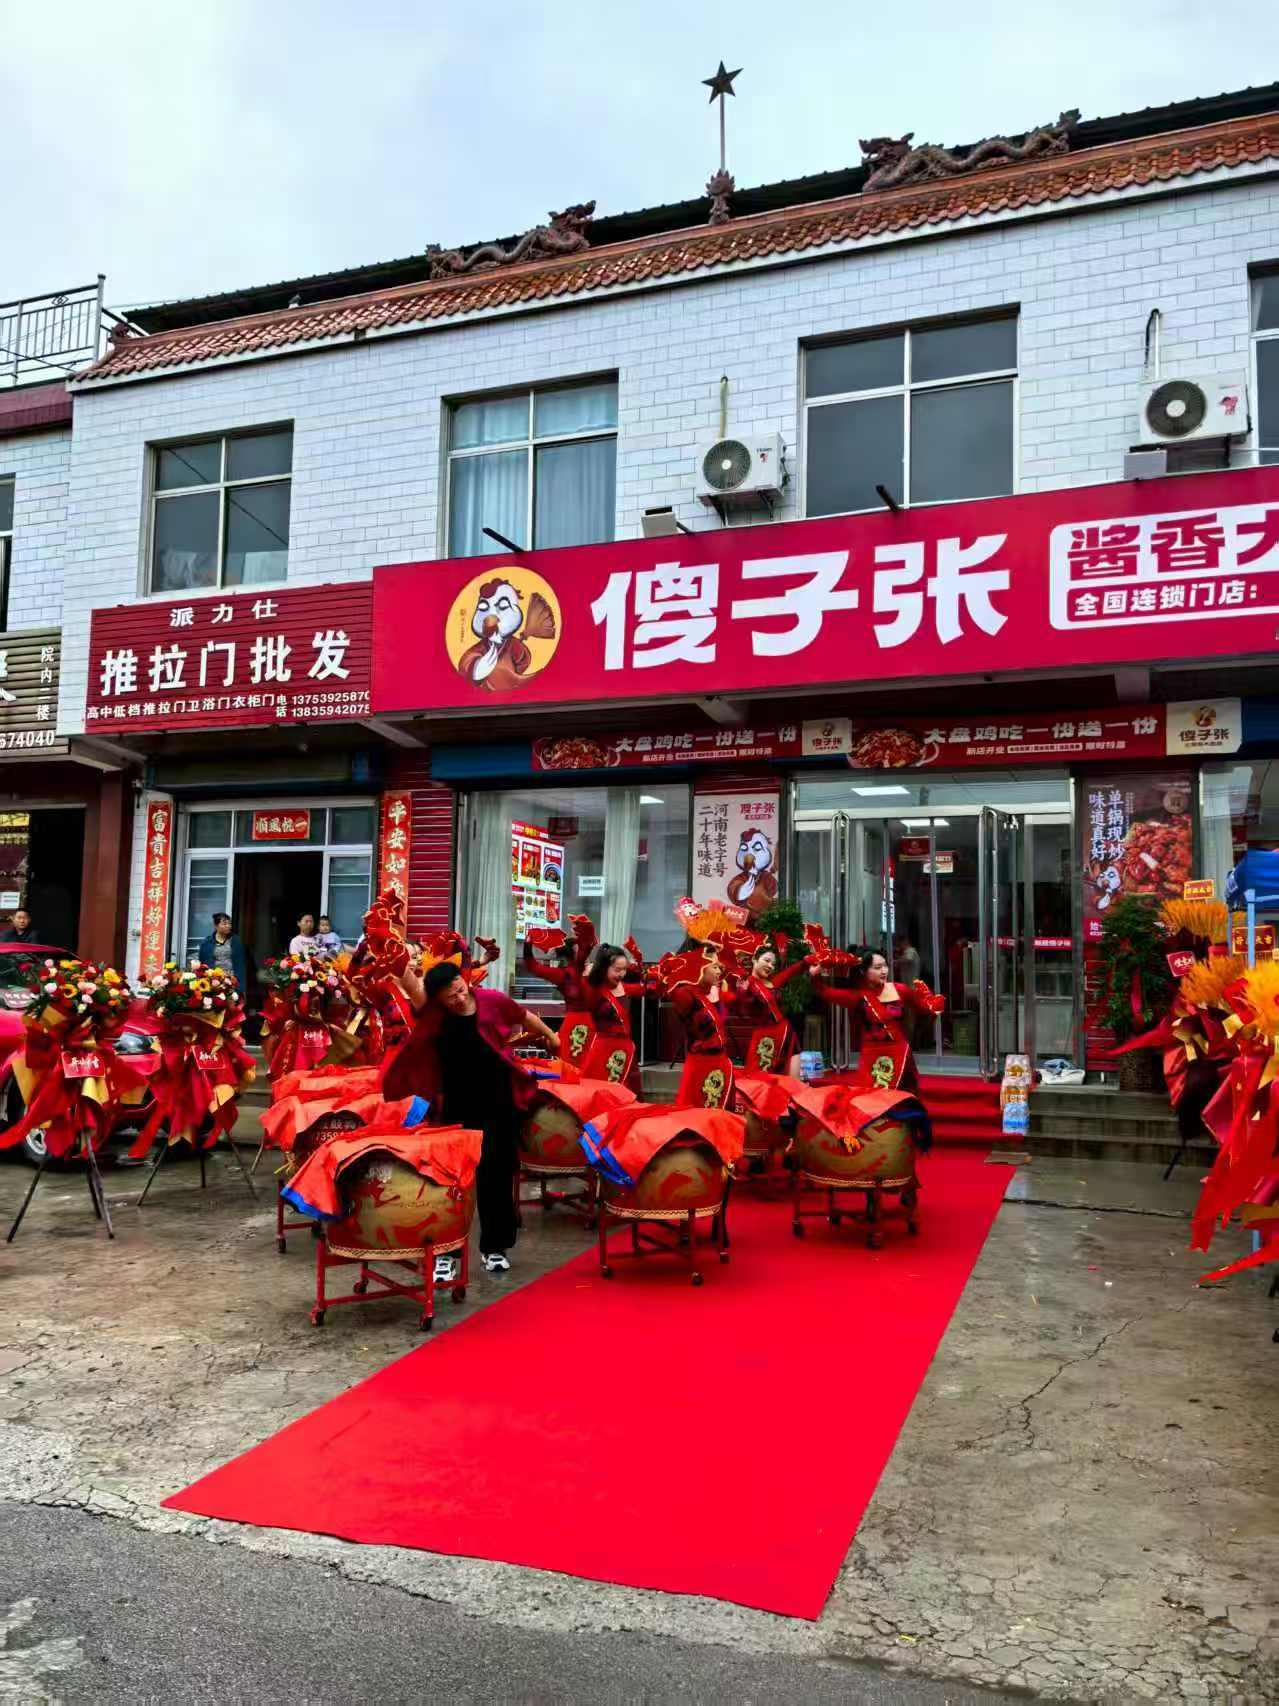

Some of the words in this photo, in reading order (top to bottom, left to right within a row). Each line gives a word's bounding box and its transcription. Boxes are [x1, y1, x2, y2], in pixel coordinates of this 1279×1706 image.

[169, 598, 279, 628] 派力仕
[591, 533, 1010, 671] 傻子张
[36, 646, 55, 721] 院内二楼
[99, 629, 351, 697] 推拉门批发
[87, 693, 275, 720] 高中低档推拉门卫浴门衣柜门
[614, 726, 798, 754] 大盘鸡吃一份送一份
[923, 716, 1159, 744] 大盘鸡吃一份送一份
[1178, 727, 1230, 743] 傻子张
[697, 805, 714, 878] 二十年味道
[712, 803, 729, 878] 河南老字号
[1088, 792, 1107, 862] 味道真好
[1106, 789, 1126, 861] 单锅现炒
